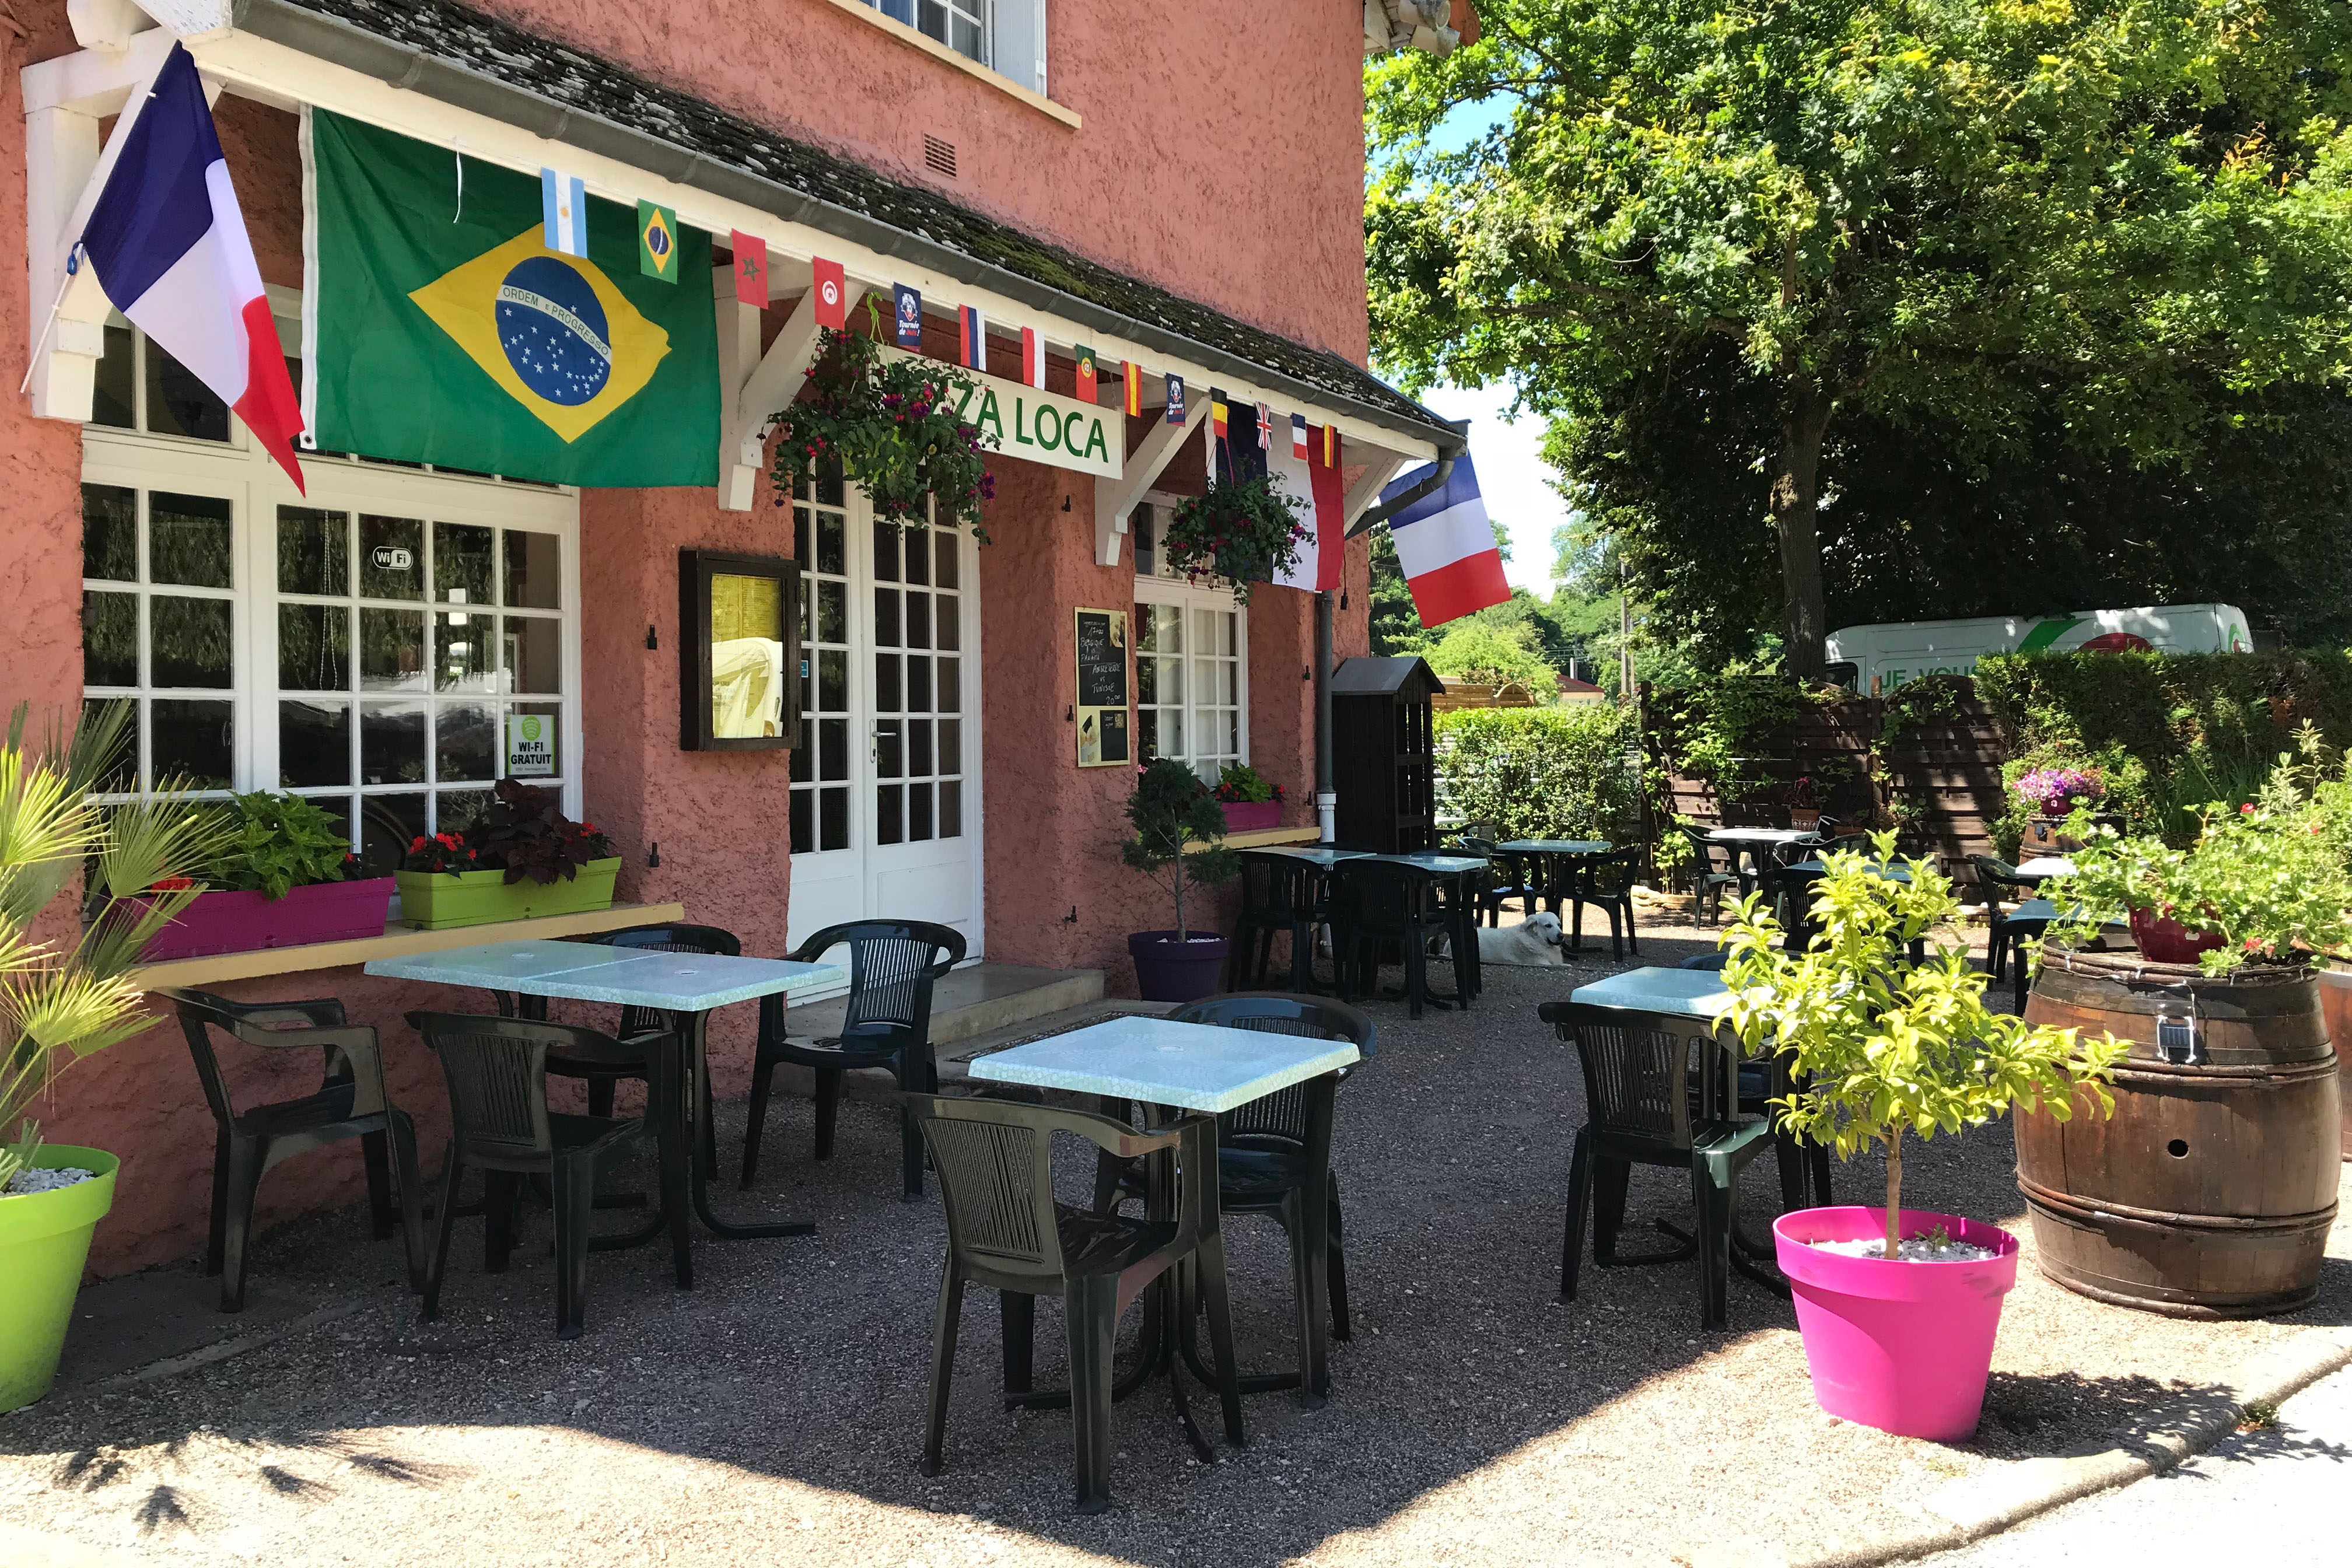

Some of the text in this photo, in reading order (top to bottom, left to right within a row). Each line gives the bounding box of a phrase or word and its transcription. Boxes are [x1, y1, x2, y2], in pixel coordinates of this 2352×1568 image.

[503, 287, 538, 306] ORDEM
[551, 306, 608, 356] PROGRESSO
[1016, 397, 1109, 463] LOCA
[511, 754, 551, 764] GRATUIT
[519, 742, 543, 752] WI-FI
